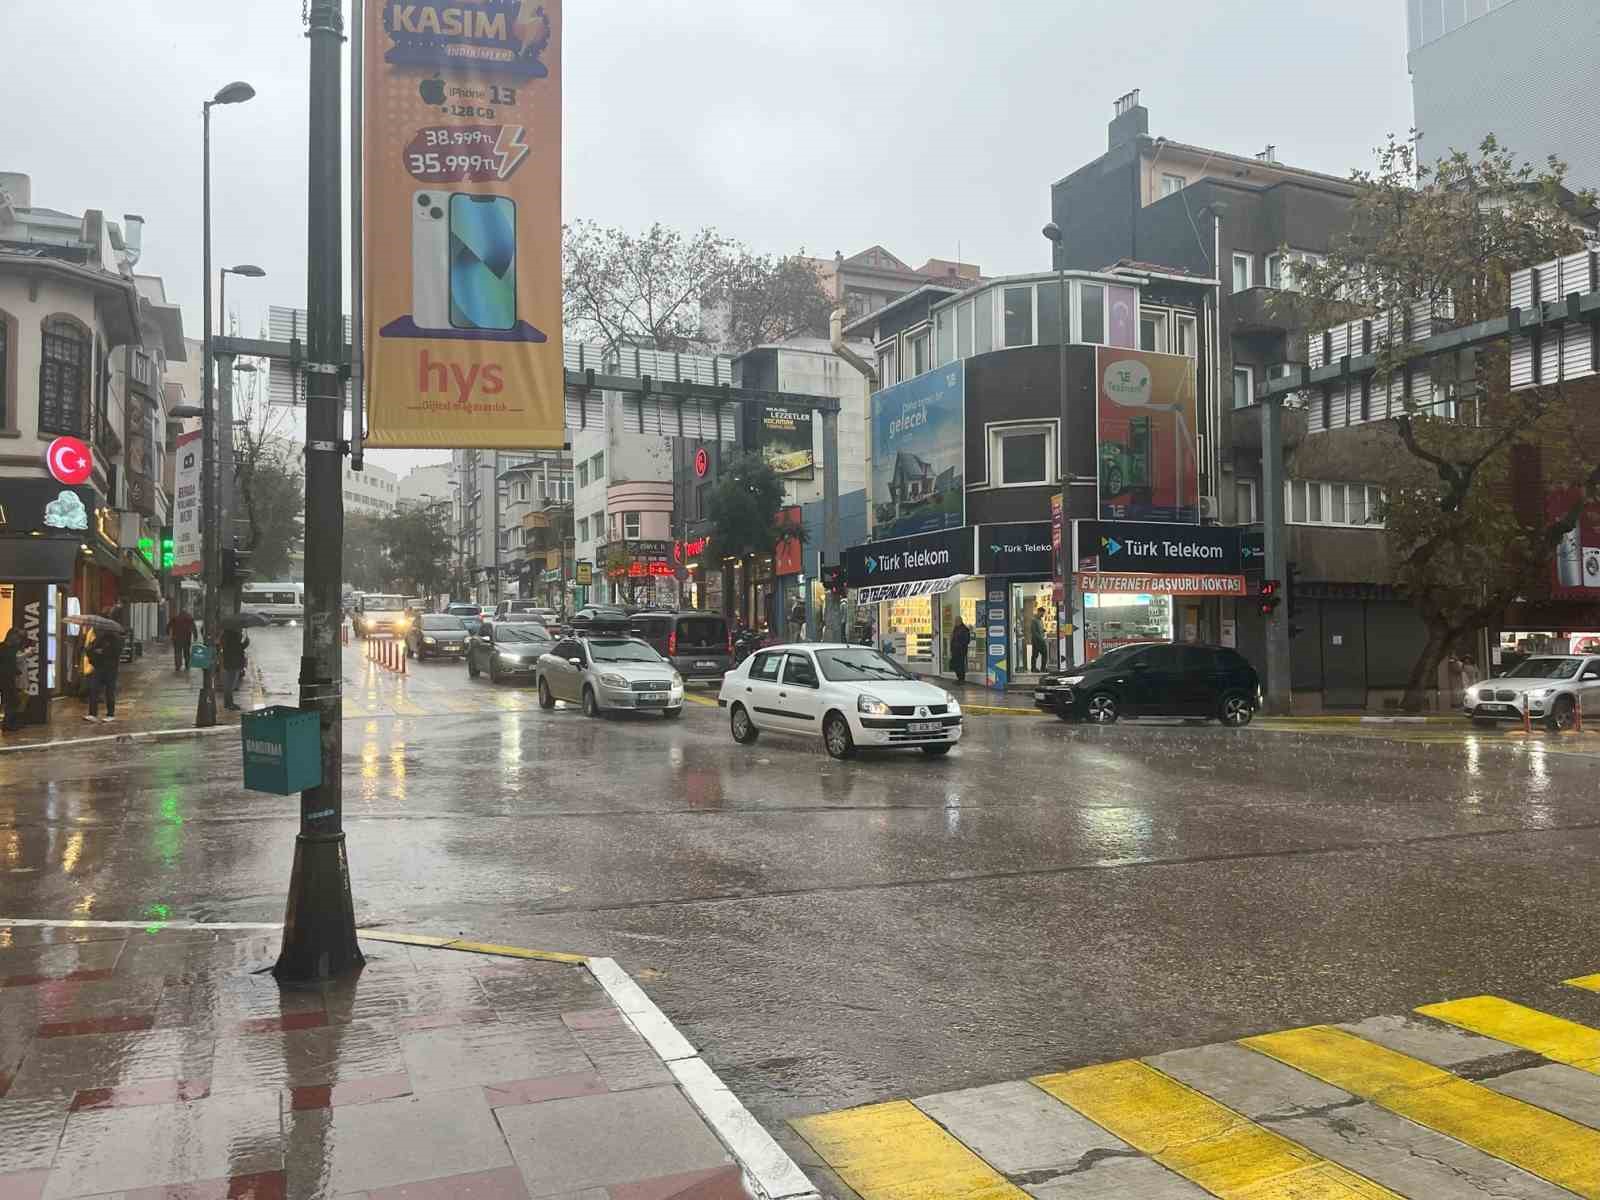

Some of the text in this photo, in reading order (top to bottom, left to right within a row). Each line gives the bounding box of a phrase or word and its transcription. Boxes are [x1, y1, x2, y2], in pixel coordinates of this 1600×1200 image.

[392, 4, 507, 40] KASIM
[489, 86, 516, 105] 13
[450, 105, 474, 116] 128
[419, 350, 504, 402] hys
[889, 407, 927, 439] gelecek
[1004, 540, 1052, 552] Türk Teleko
[1125, 540, 1223, 559] Türk Telekom
[878, 549, 949, 572] Türk Telekom
[1081, 577, 1096, 590] EV
[1151, 579, 1199, 593] BAŞVURU
